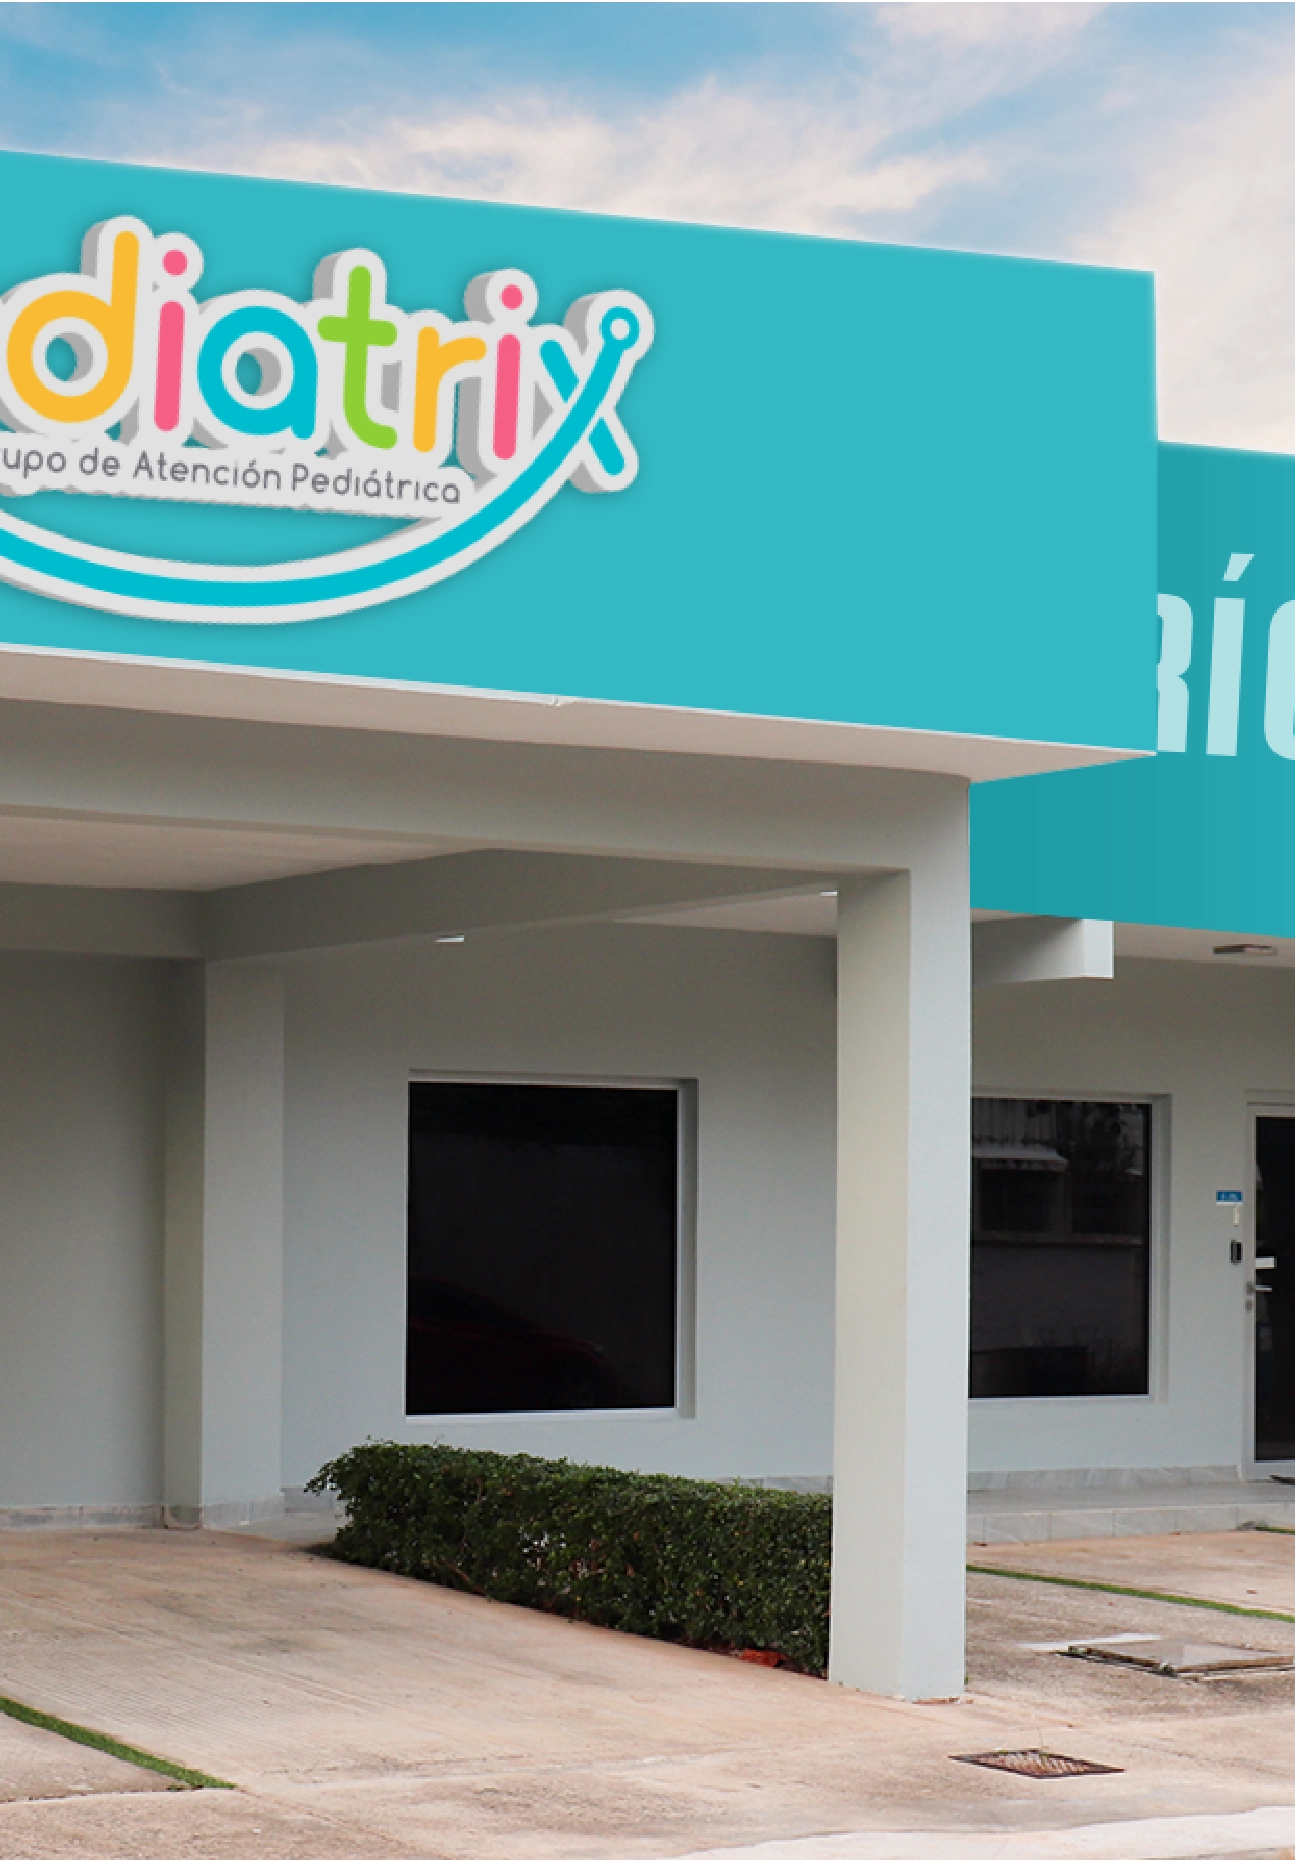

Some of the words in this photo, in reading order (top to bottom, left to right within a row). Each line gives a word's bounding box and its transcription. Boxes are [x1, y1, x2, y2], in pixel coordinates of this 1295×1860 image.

[79, 446, 120, 477] de
[133, 450, 283, 491] Atención
[291, 464, 461, 504] Pediátrica
